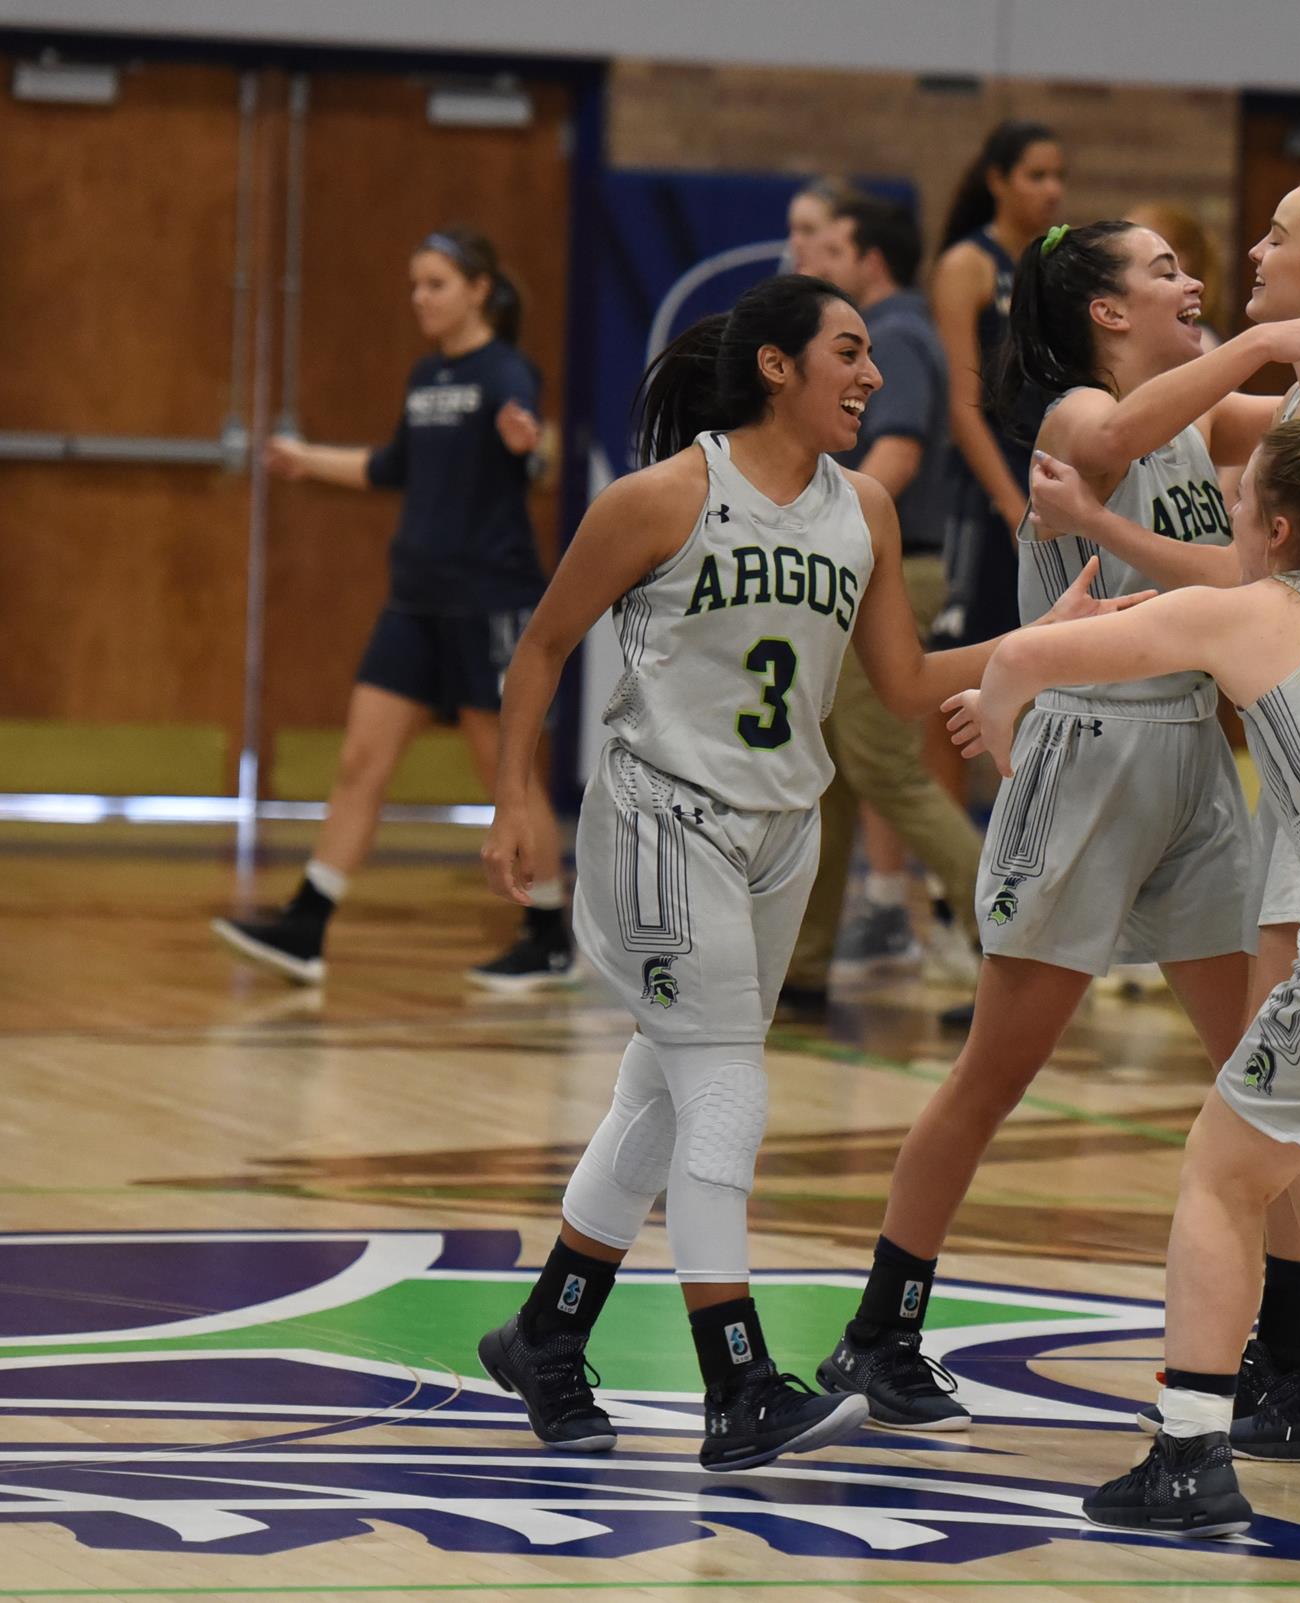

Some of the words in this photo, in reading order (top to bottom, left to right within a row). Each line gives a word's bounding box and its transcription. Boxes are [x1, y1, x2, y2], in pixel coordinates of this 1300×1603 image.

[1152, 480, 1235, 542] ARGO
[683, 544, 859, 633] ARGOS
[734, 635, 799, 751] 3
